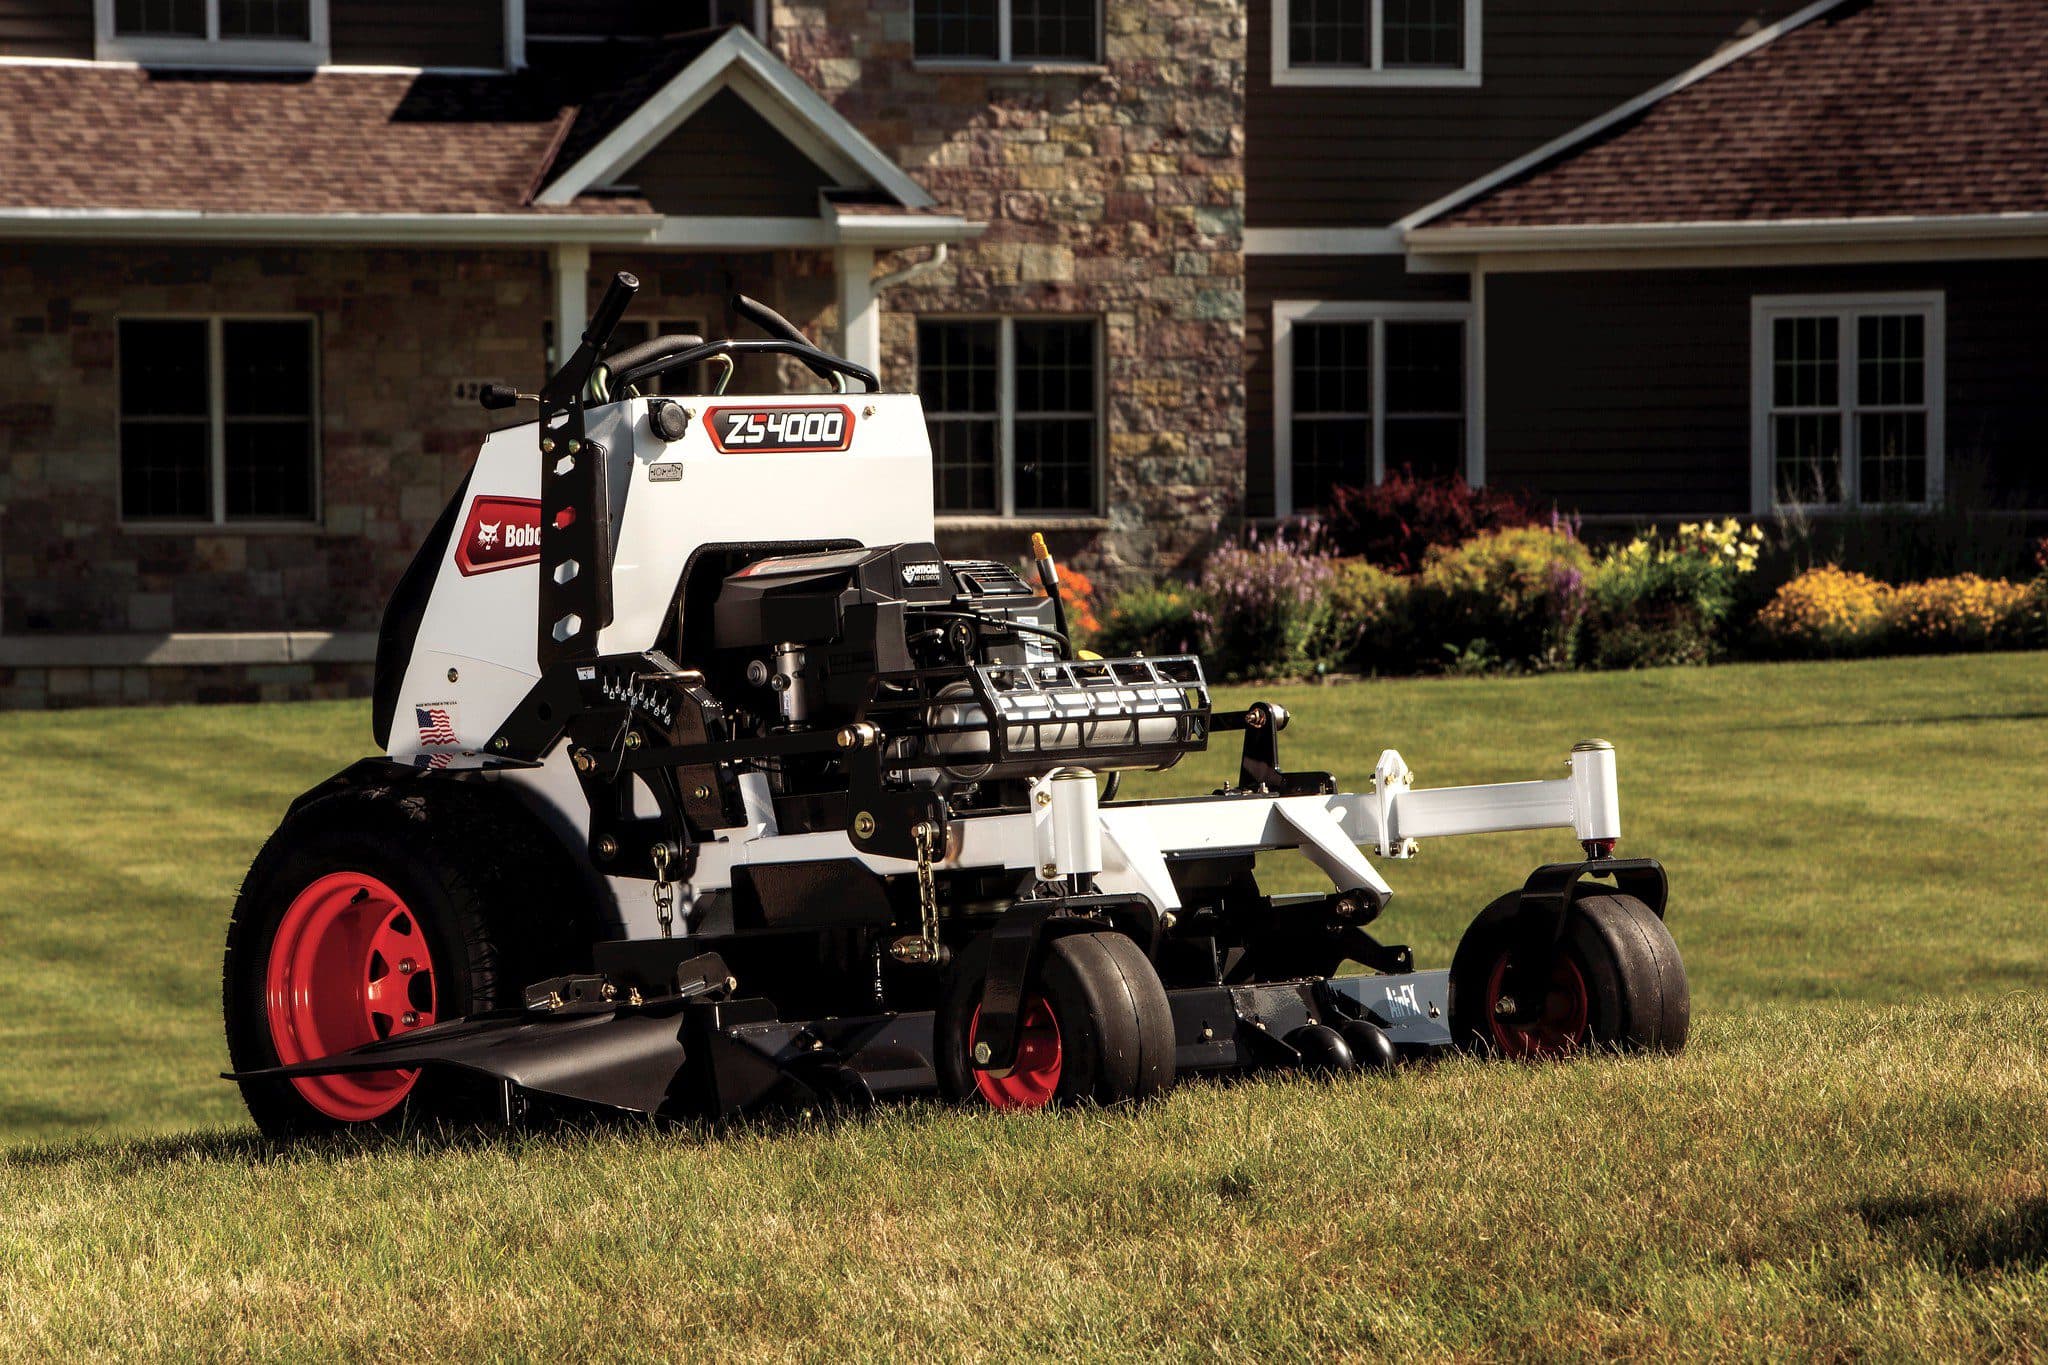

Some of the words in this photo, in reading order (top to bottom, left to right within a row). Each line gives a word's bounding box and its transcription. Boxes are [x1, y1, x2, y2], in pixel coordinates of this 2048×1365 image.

[725, 412, 844, 444] ZS4000
[904, 564, 940, 575] VORTICAL
[1385, 983, 1422, 1018] AirFX
